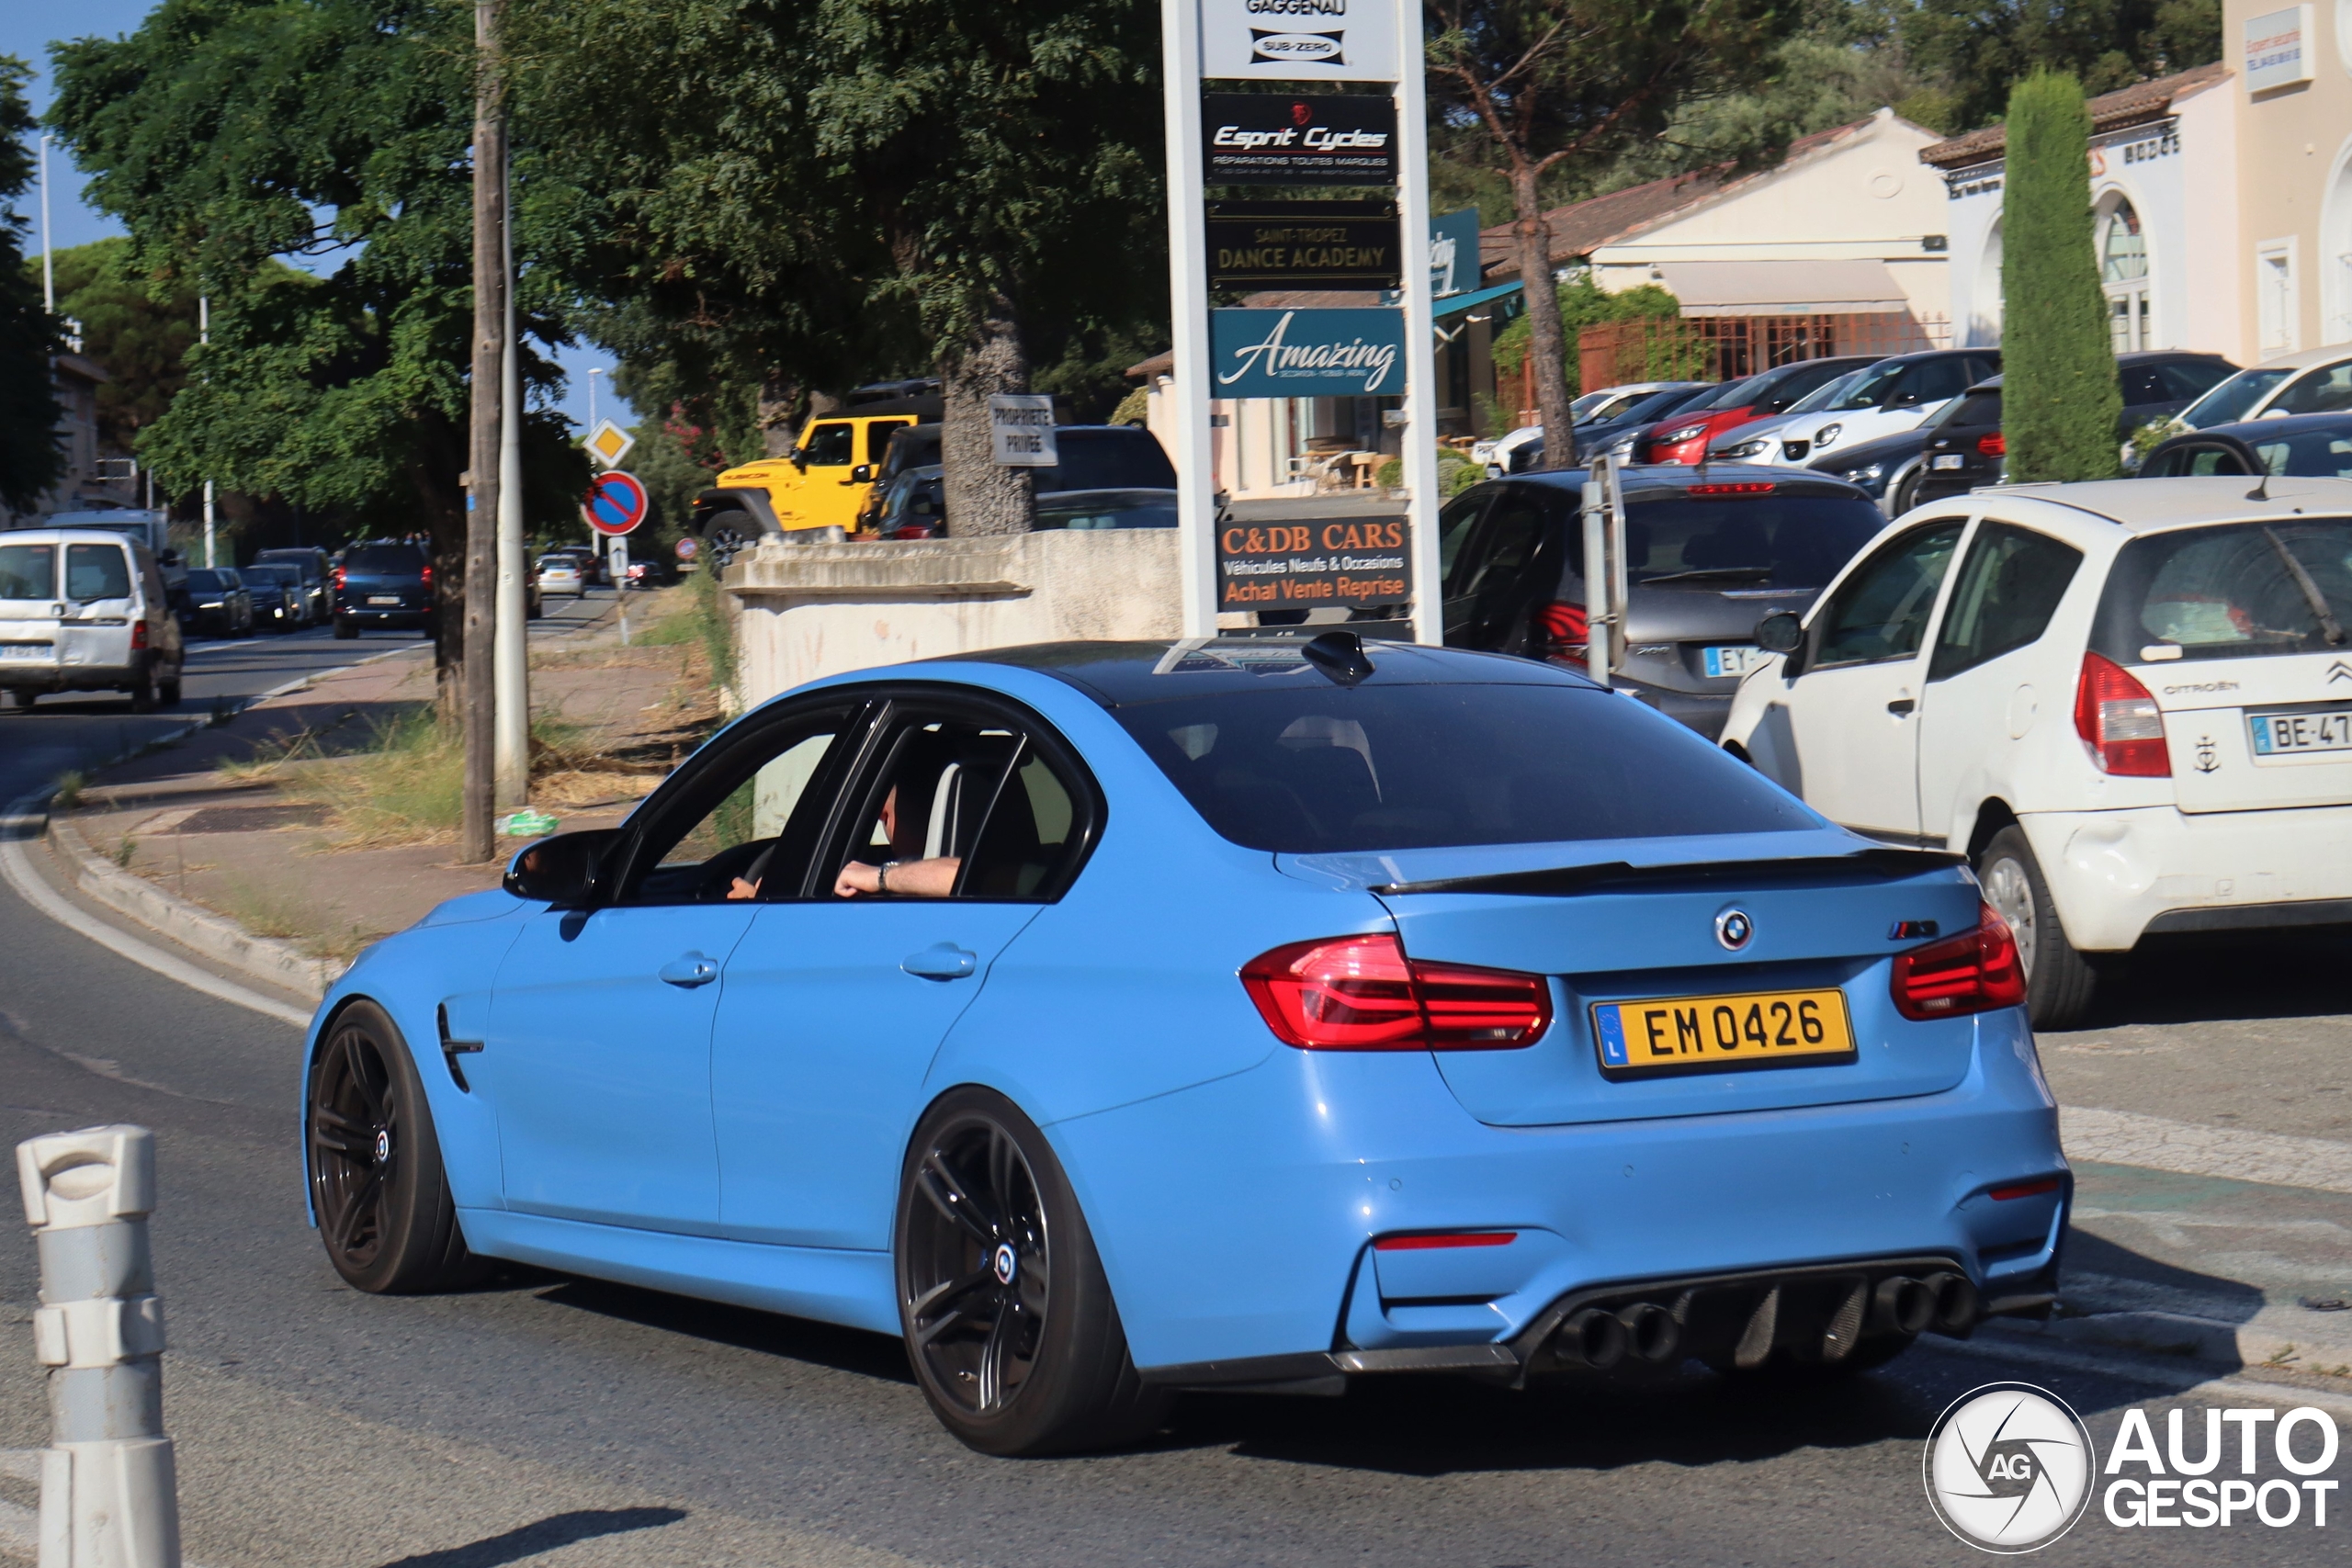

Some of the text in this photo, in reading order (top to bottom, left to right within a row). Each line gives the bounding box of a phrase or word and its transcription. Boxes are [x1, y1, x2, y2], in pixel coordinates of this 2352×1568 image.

[1247, 0, 1345, 16] GAGGENAU
[1263, 41, 1332, 52] SUB-ZERO
[1213, 126, 1388, 152] Esprit Cycles
[1292, 156, 1334, 166] TOUTES
[1335, 157, 1388, 167] MARQUES
[1255, 228, 1348, 243] SAINT-TROPEZ
[1218, 247, 1385, 269] DANCE ACADEMY
[1217, 310, 1398, 392] Amazing
[1222, 523, 1403, 554] C&DB CARS
[1224, 555, 1404, 576] Véhicules Neufs & Occasions
[1225, 575, 1405, 602] Achat Vente Reprise
[1645, 999, 1824, 1055] EM 0426
[1609, 1042, 1620, 1056] L
